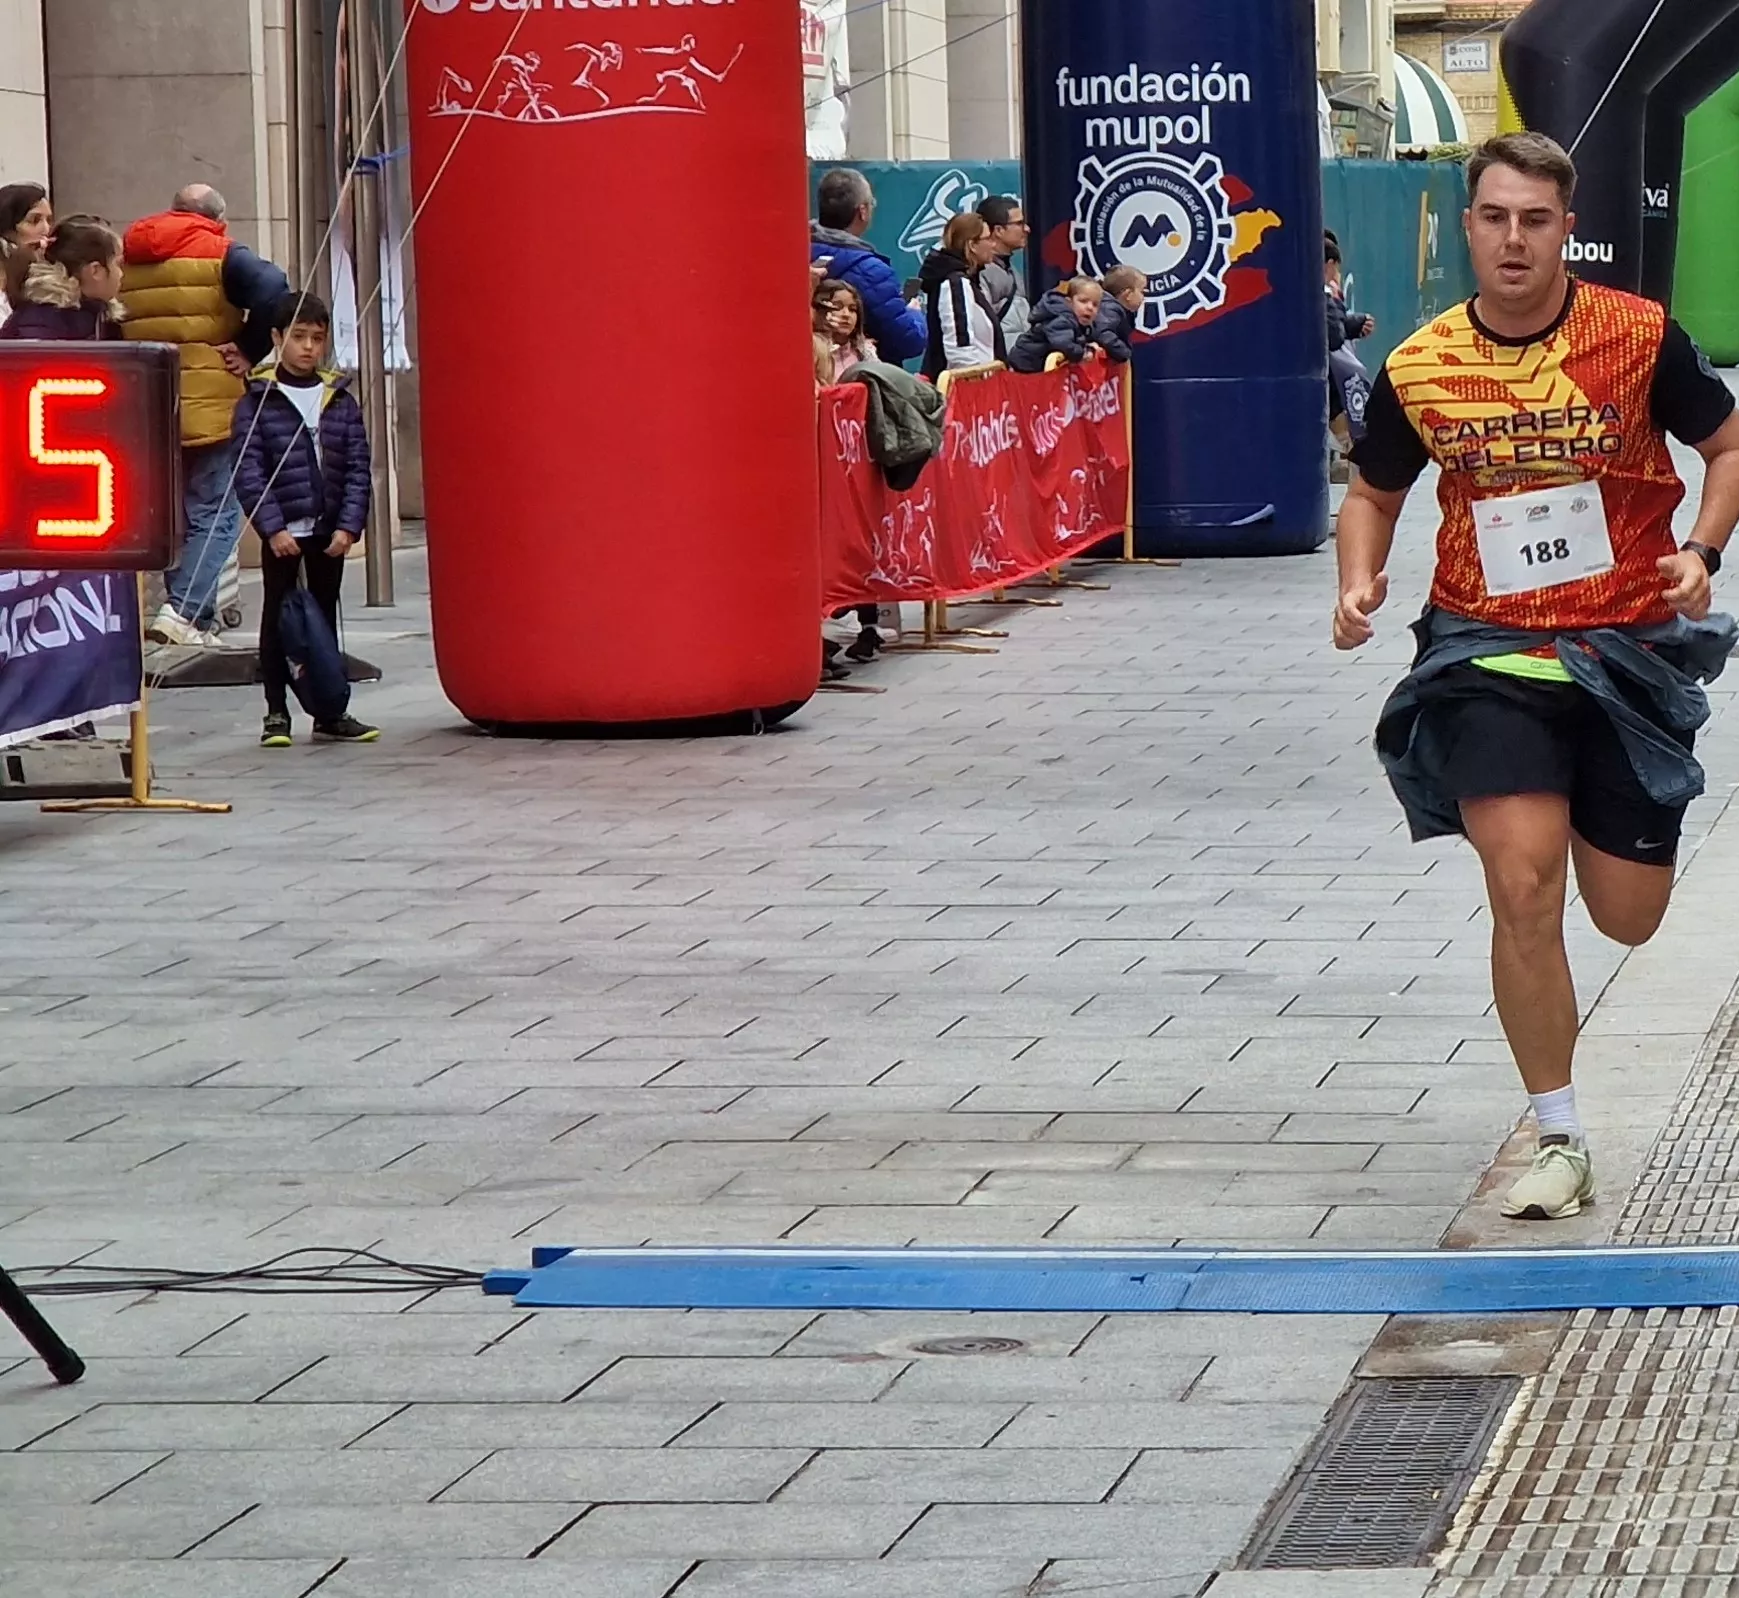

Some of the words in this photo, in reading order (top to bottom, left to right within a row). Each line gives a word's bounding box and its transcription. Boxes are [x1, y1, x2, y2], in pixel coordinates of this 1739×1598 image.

[1056, 62, 1250, 106] fundación
[1086, 105, 1210, 152] mupol
[1432, 402, 1622, 446] CARRERA
[29, 378, 114, 537] 5
[1513, 434, 1624, 464] EBRO
[1519, 537, 1571, 567] 188
